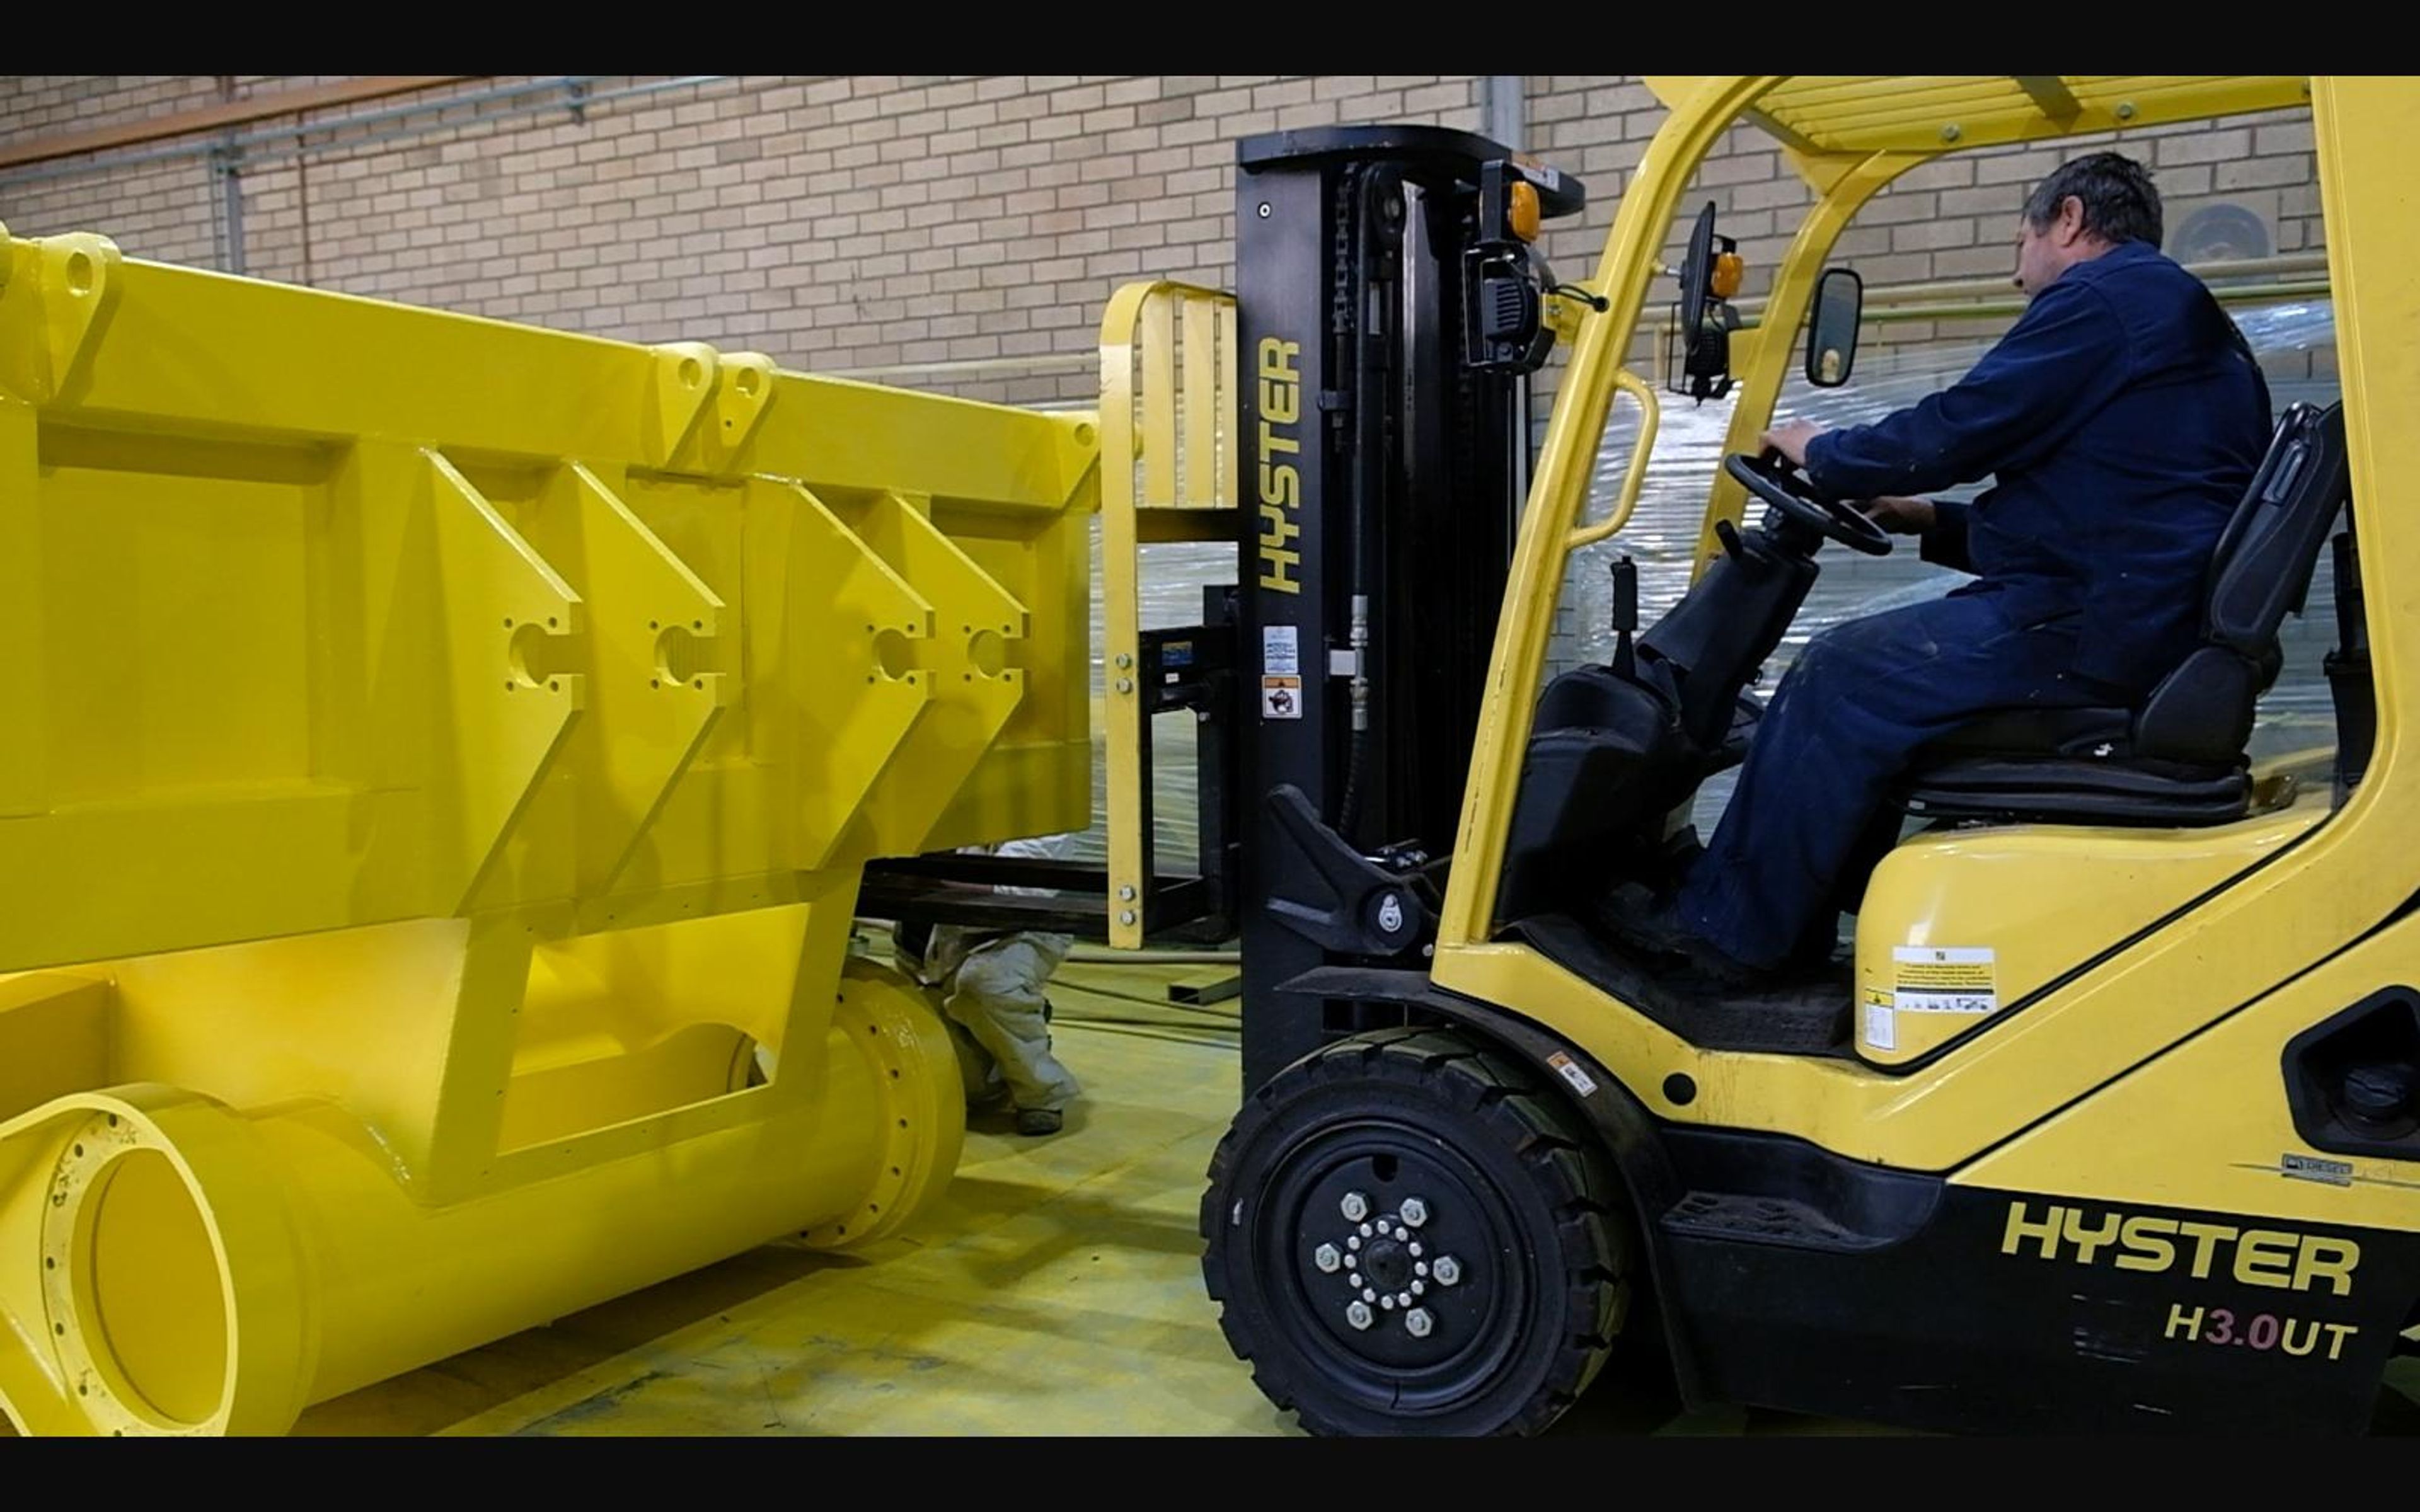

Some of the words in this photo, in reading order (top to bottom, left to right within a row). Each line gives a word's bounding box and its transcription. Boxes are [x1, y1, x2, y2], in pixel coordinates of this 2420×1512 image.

[1259, 337, 1299, 593] HYSTER
[2002, 1201, 2360, 1295] HYSTER
[2164, 1303, 2359, 1360] H3.0UT
